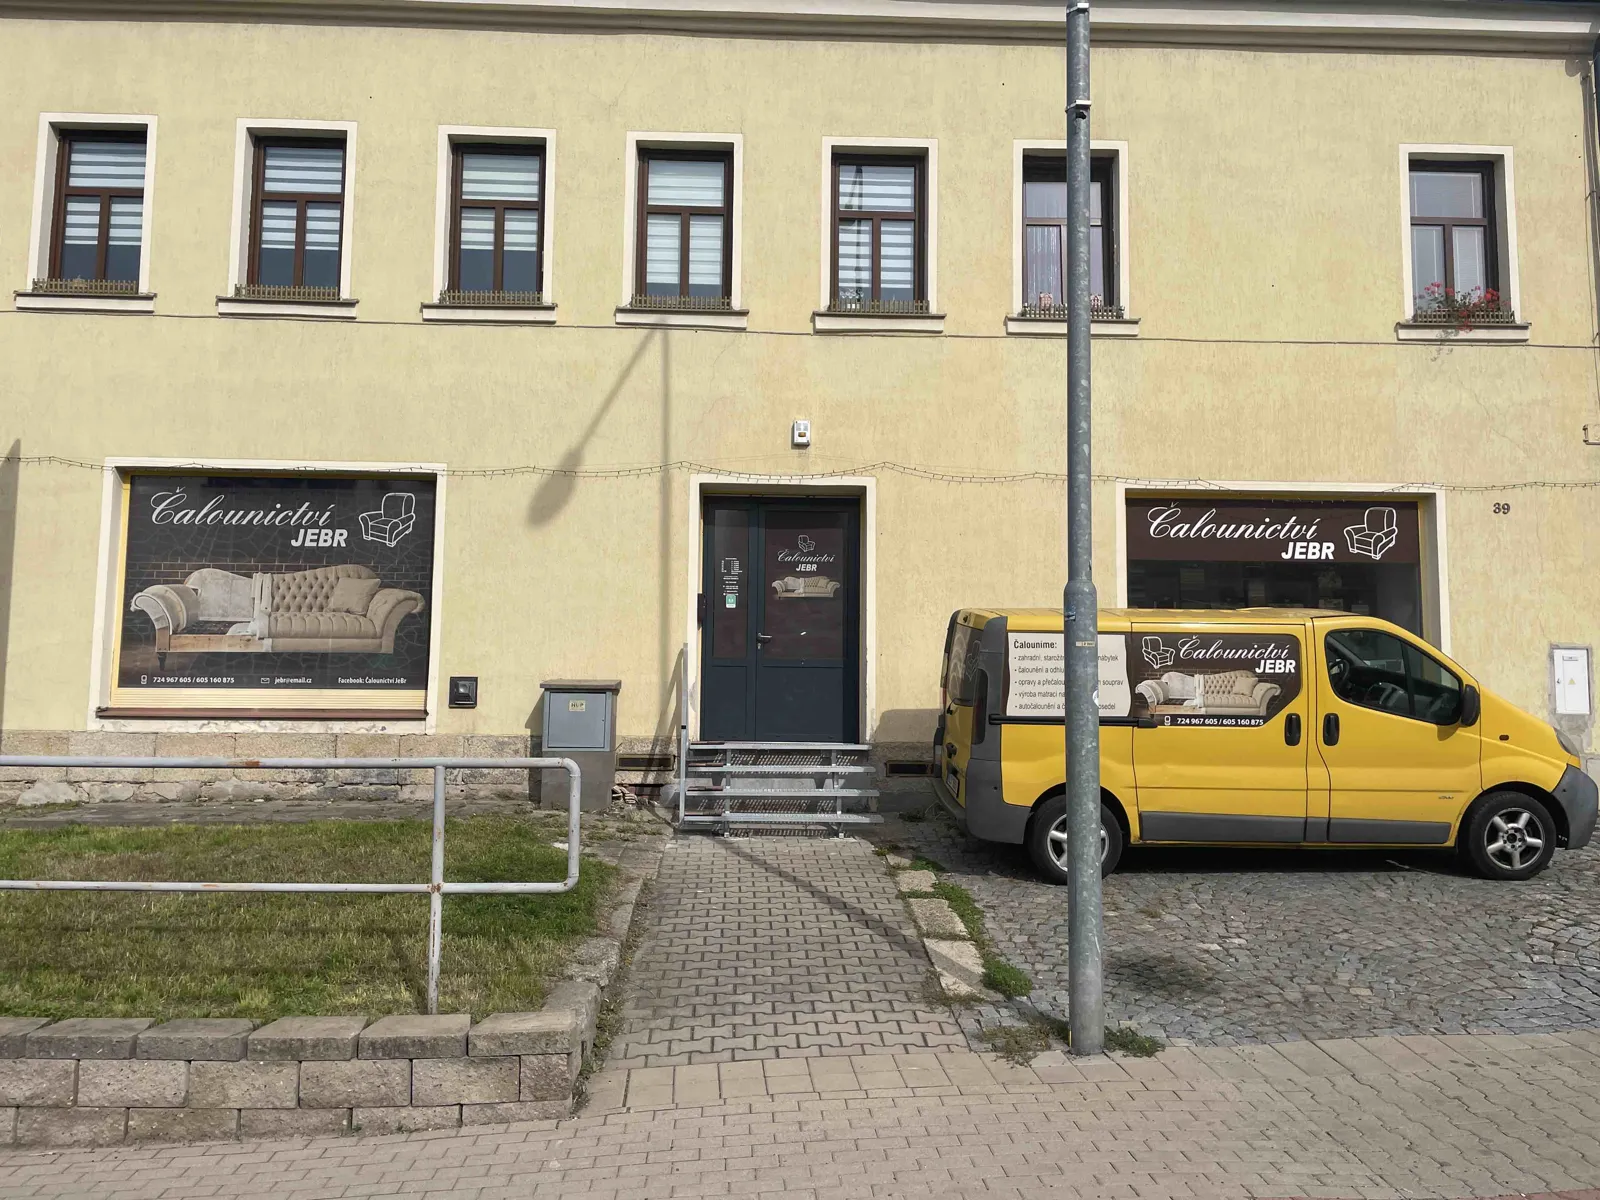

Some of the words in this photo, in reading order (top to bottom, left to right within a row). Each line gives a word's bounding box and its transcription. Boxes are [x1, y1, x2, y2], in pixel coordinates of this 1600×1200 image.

[150, 486, 336, 526] Čalounictví
[1493, 502, 1511, 515] 39
[1147, 501, 1321, 540] Čalounictví
[290, 528, 349, 547] JEBR
[777, 548, 836, 563] Čalounictví
[1281, 541, 1336, 560] JEBR
[795, 563, 818, 572] JEBR
[1177, 635, 1291, 660] Čalounictví
[1255, 659, 1297, 674] JEBR
[152, 676, 165, 684] 724
[166, 676, 179, 684] 967
[179, 676, 192, 684] 605
[196, 676, 209, 684] 605
[210, 676, 222, 684] 160
[338, 676, 365, 684] Facebook:
[1018, 679, 1036, 687] opravy
[1102, 679, 1123, 687] souprav
[1018, 690, 1037, 699] výroba
[1177, 717, 1190, 725] 724
[1191, 717, 1204, 725] 967
[1237, 718, 1250, 726] 160
[1250, 718, 1264, 726] 875
